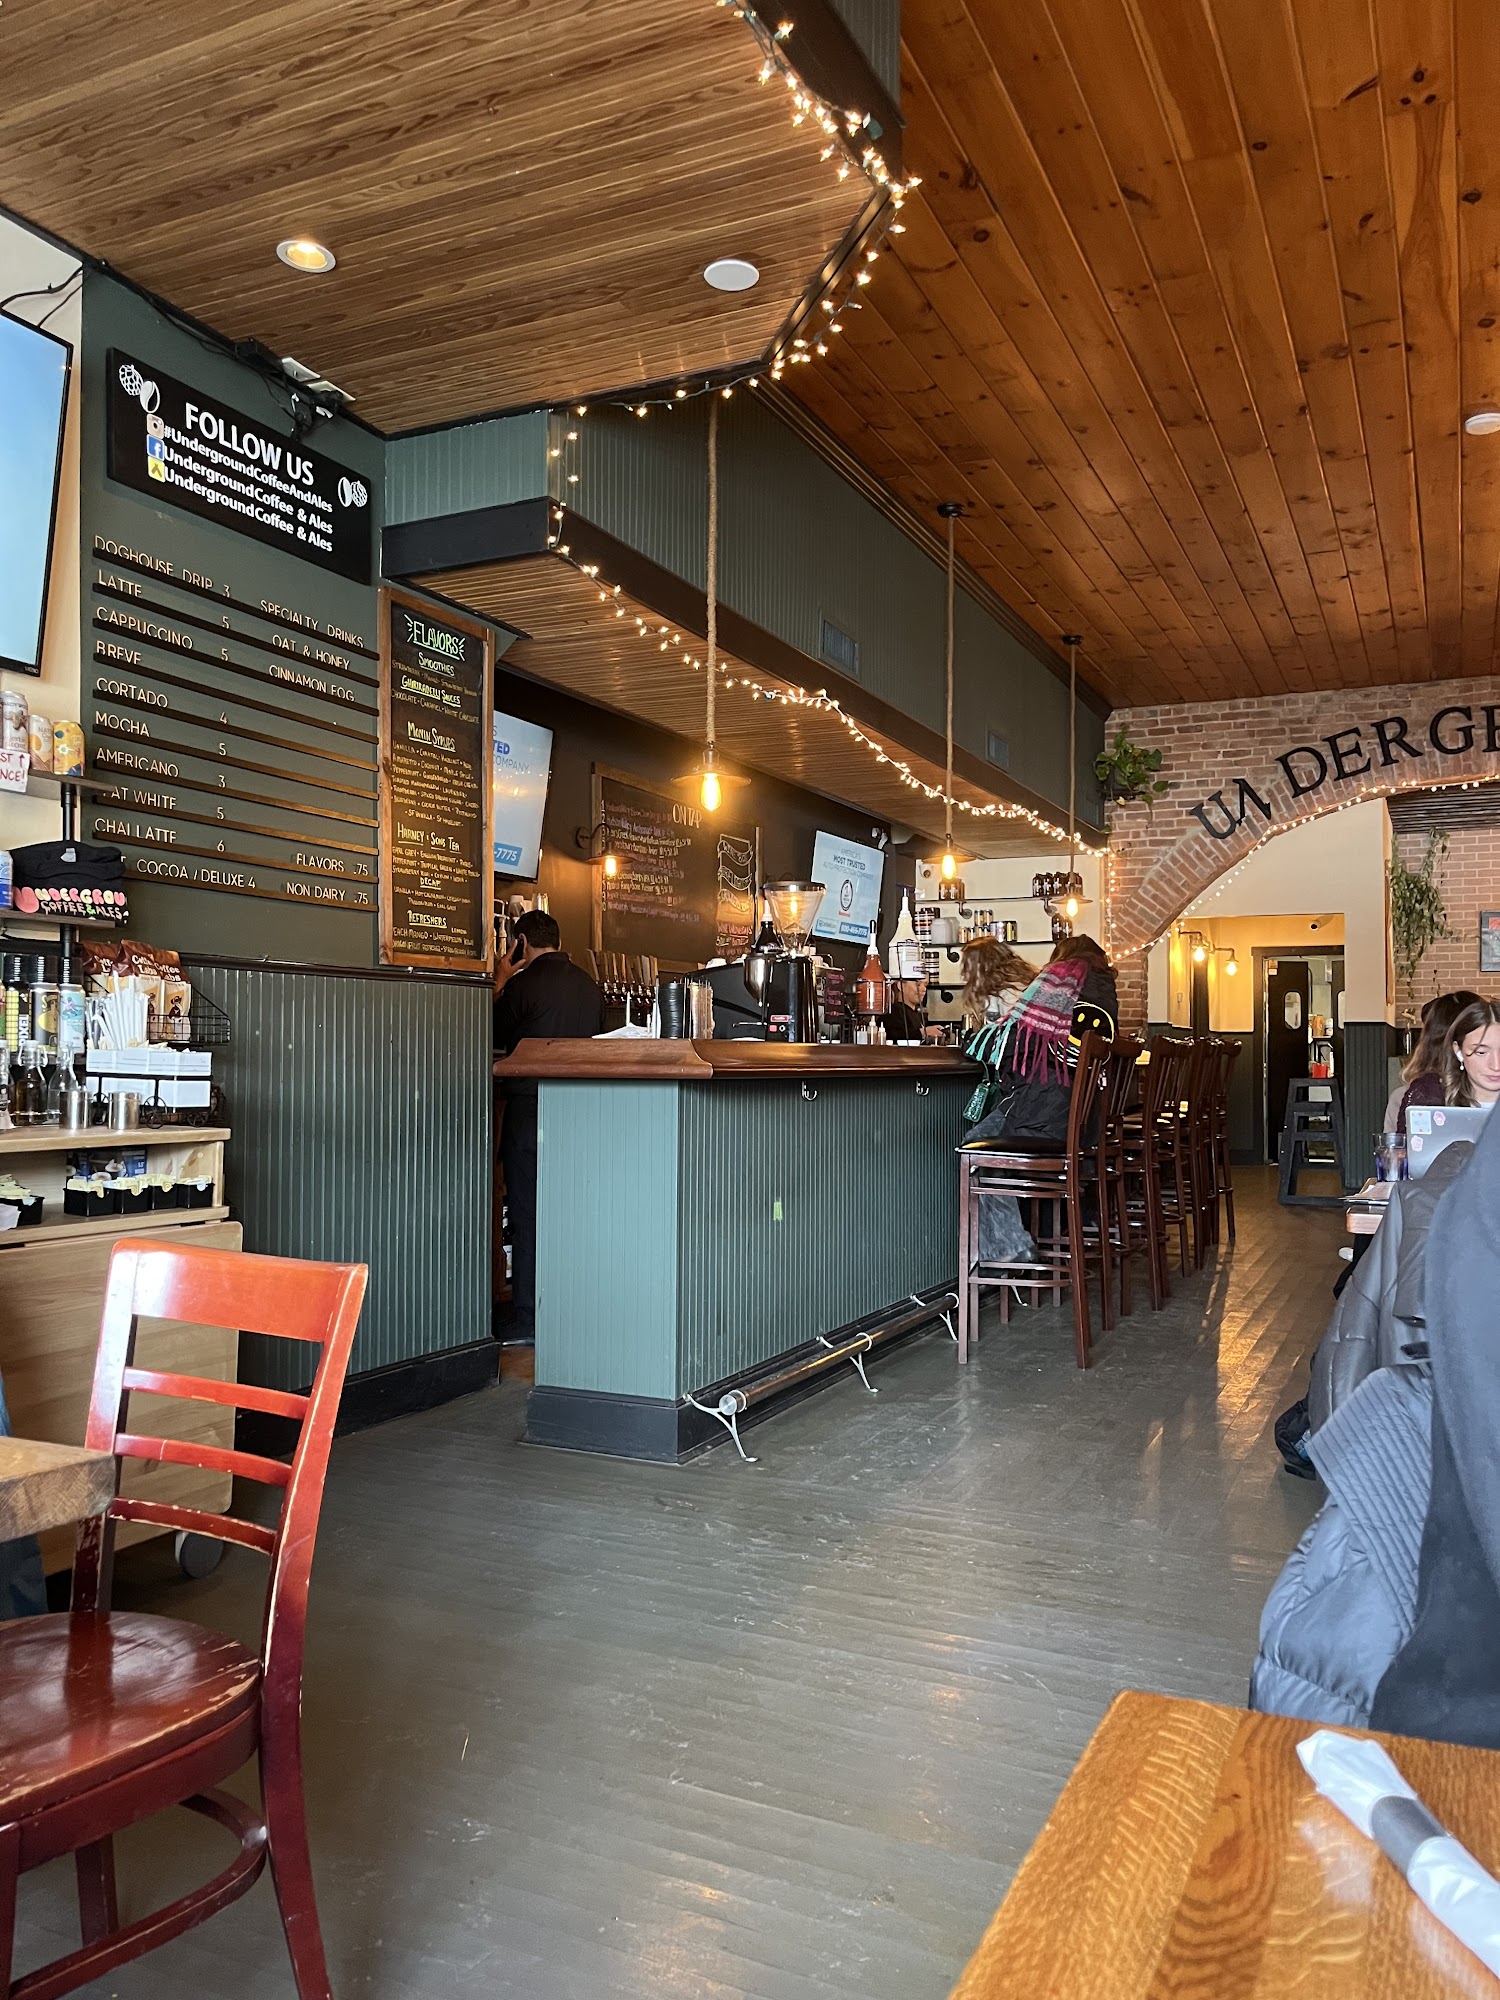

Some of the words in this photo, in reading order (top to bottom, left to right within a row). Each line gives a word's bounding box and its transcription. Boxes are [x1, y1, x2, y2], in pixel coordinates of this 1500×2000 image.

[186, 402, 281, 470] FOLLOW
[286, 452, 314, 486] US
[164, 424, 333, 513] #UndergroundCoffeeAndAles
[164, 446, 294, 516] UndergroundCoffee
[297, 508, 306, 522] &
[309, 512, 333, 534] Ales
[164, 466, 294, 535] UndergroundCoffee
[296, 526, 306, 541] &
[308, 531, 332, 552] Ales
[94, 535, 173, 574] DOGHOUSE
[182, 569, 213, 590] DRIP
[223, 585, 230, 597] 3
[98, 569, 142, 597] LATTE
[222, 617, 230, 629] 5
[96, 607, 193, 649] CAPPUCCINO
[221, 648, 228, 661] 5
[260, 600, 318, 630] SPECIALTY
[327, 624, 363, 647] DRINKS
[413, 621, 459, 655] FLAVORS
[96, 641, 142, 664] BREVE
[272, 635, 296, 651] OAT
[303, 646, 310, 657] &
[316, 650, 350, 670] HONEY
[269, 665, 326, 693] CINNAMON
[96, 678, 168, 707] CORTADO
[220, 712, 227, 724] 4
[95, 711, 149, 737] MOCHA
[219, 743, 226, 756] 5
[96, 748, 179, 777] AMERICANO
[218, 775, 225, 788] 3
[134, 790, 176, 809] WHITE
[216, 807, 224, 820] 5
[673, 804, 686, 825] ON
[95, 818, 130, 836] CHAI
[137, 826, 176, 844] LATTE
[217, 840, 225, 852] 6
[397, 822, 424, 842] HARNEY
[137, 859, 188, 880] COCOA
[202, 869, 245, 887] DELUXE
[248, 876, 256, 889] 4
[296, 853, 344, 873] FLAVORS
[353, 863, 368, 876] .75
[12, 887, 127, 913] UNDERGROU
[287, 882, 311, 897] NON
[314, 885, 345, 902] DAIRY
[353, 892, 368, 905] .75
